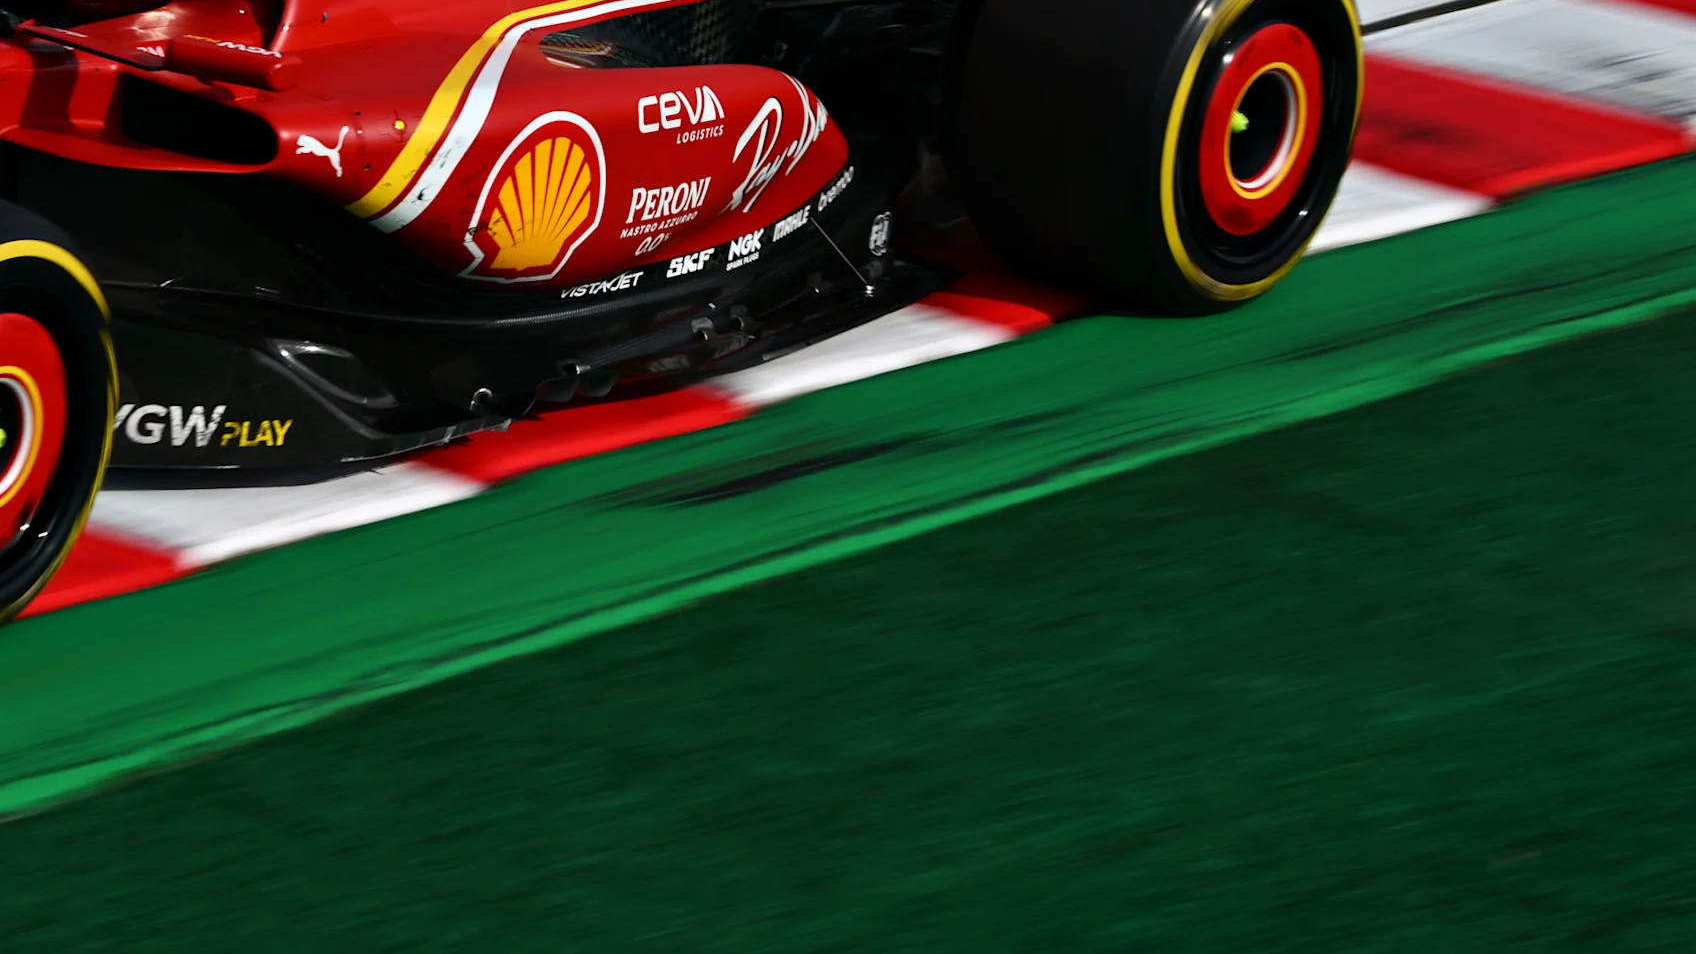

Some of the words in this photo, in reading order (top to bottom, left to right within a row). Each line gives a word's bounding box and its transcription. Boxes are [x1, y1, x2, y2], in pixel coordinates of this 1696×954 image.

[676, 124, 724, 144] LOGISTICS
[625, 177, 712, 224] PERONI
[620, 224, 658, 239] NASTRO
[658, 211, 698, 230] AZZURRO
[772, 204, 812, 243] MAHLE
[728, 228, 764, 261] NGK
[666, 248, 715, 279] SKF
[220, 419, 294, 447] PLAY
